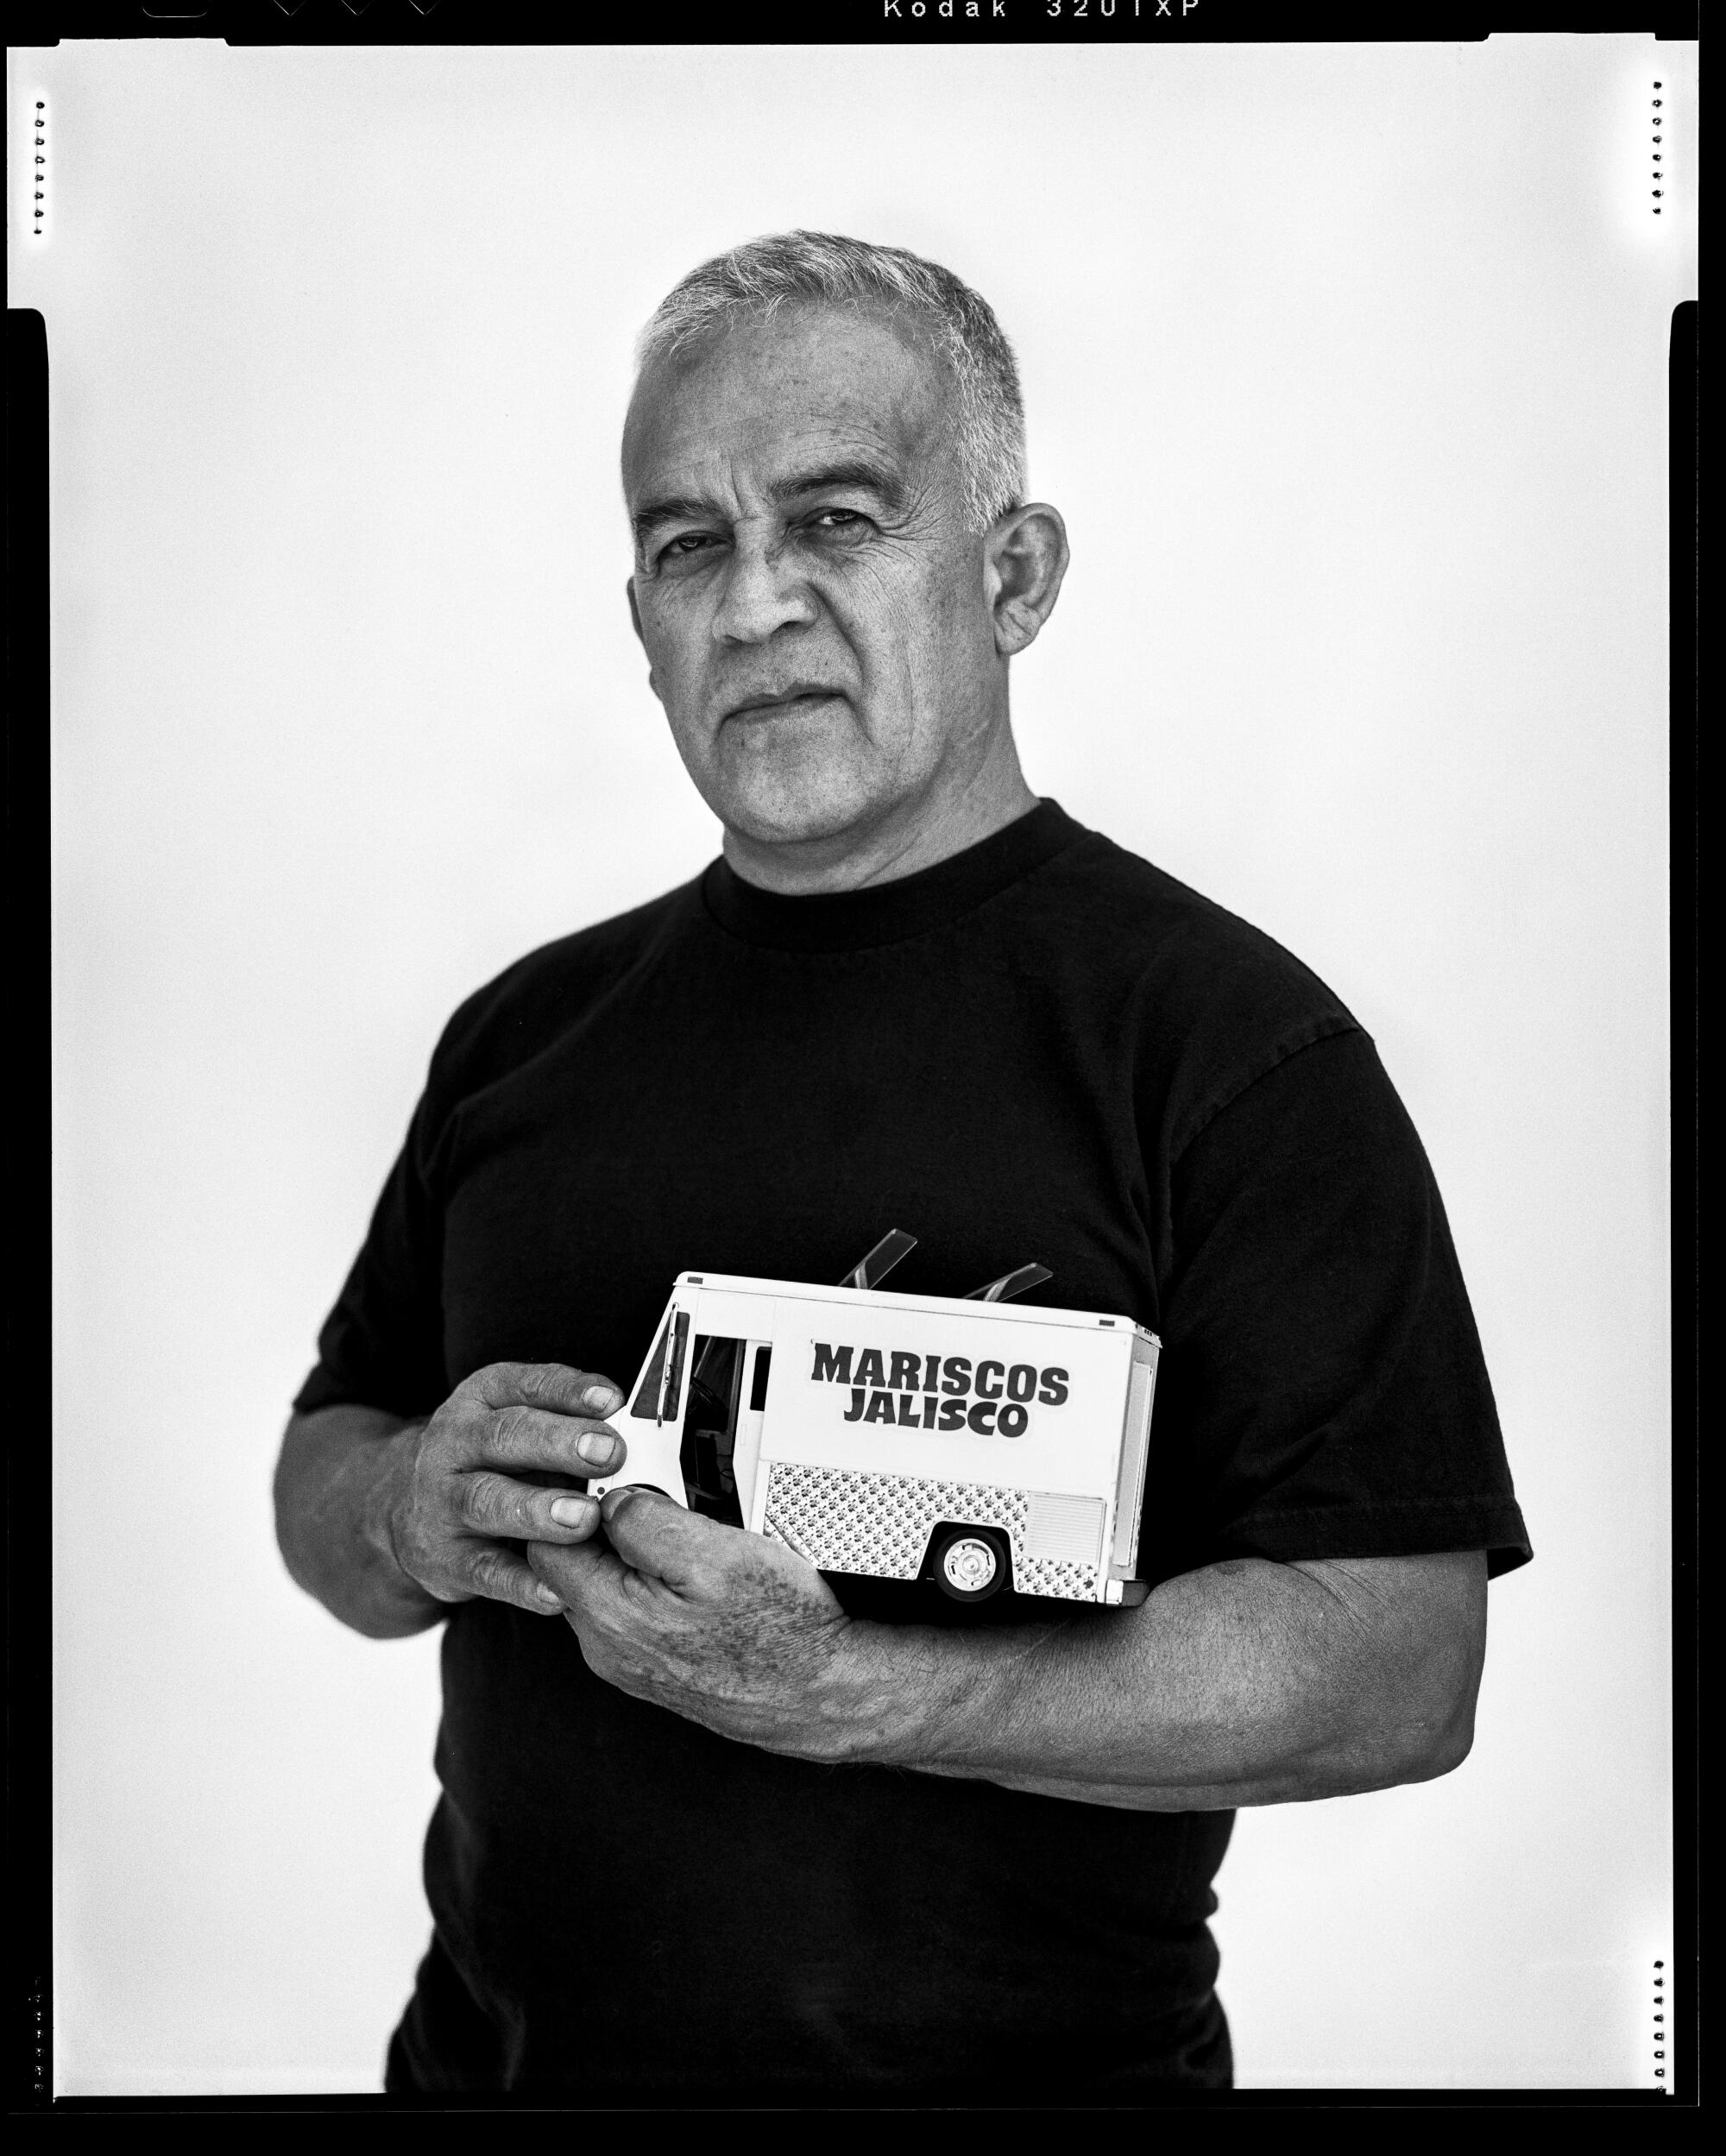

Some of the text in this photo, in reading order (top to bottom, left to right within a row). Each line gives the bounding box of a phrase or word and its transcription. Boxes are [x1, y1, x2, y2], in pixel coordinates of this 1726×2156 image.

[884, 0, 1005, 17] Kodak
[810, 1342, 1069, 1406] MARISCOS
[843, 1388, 1029, 1438] JALISCO
